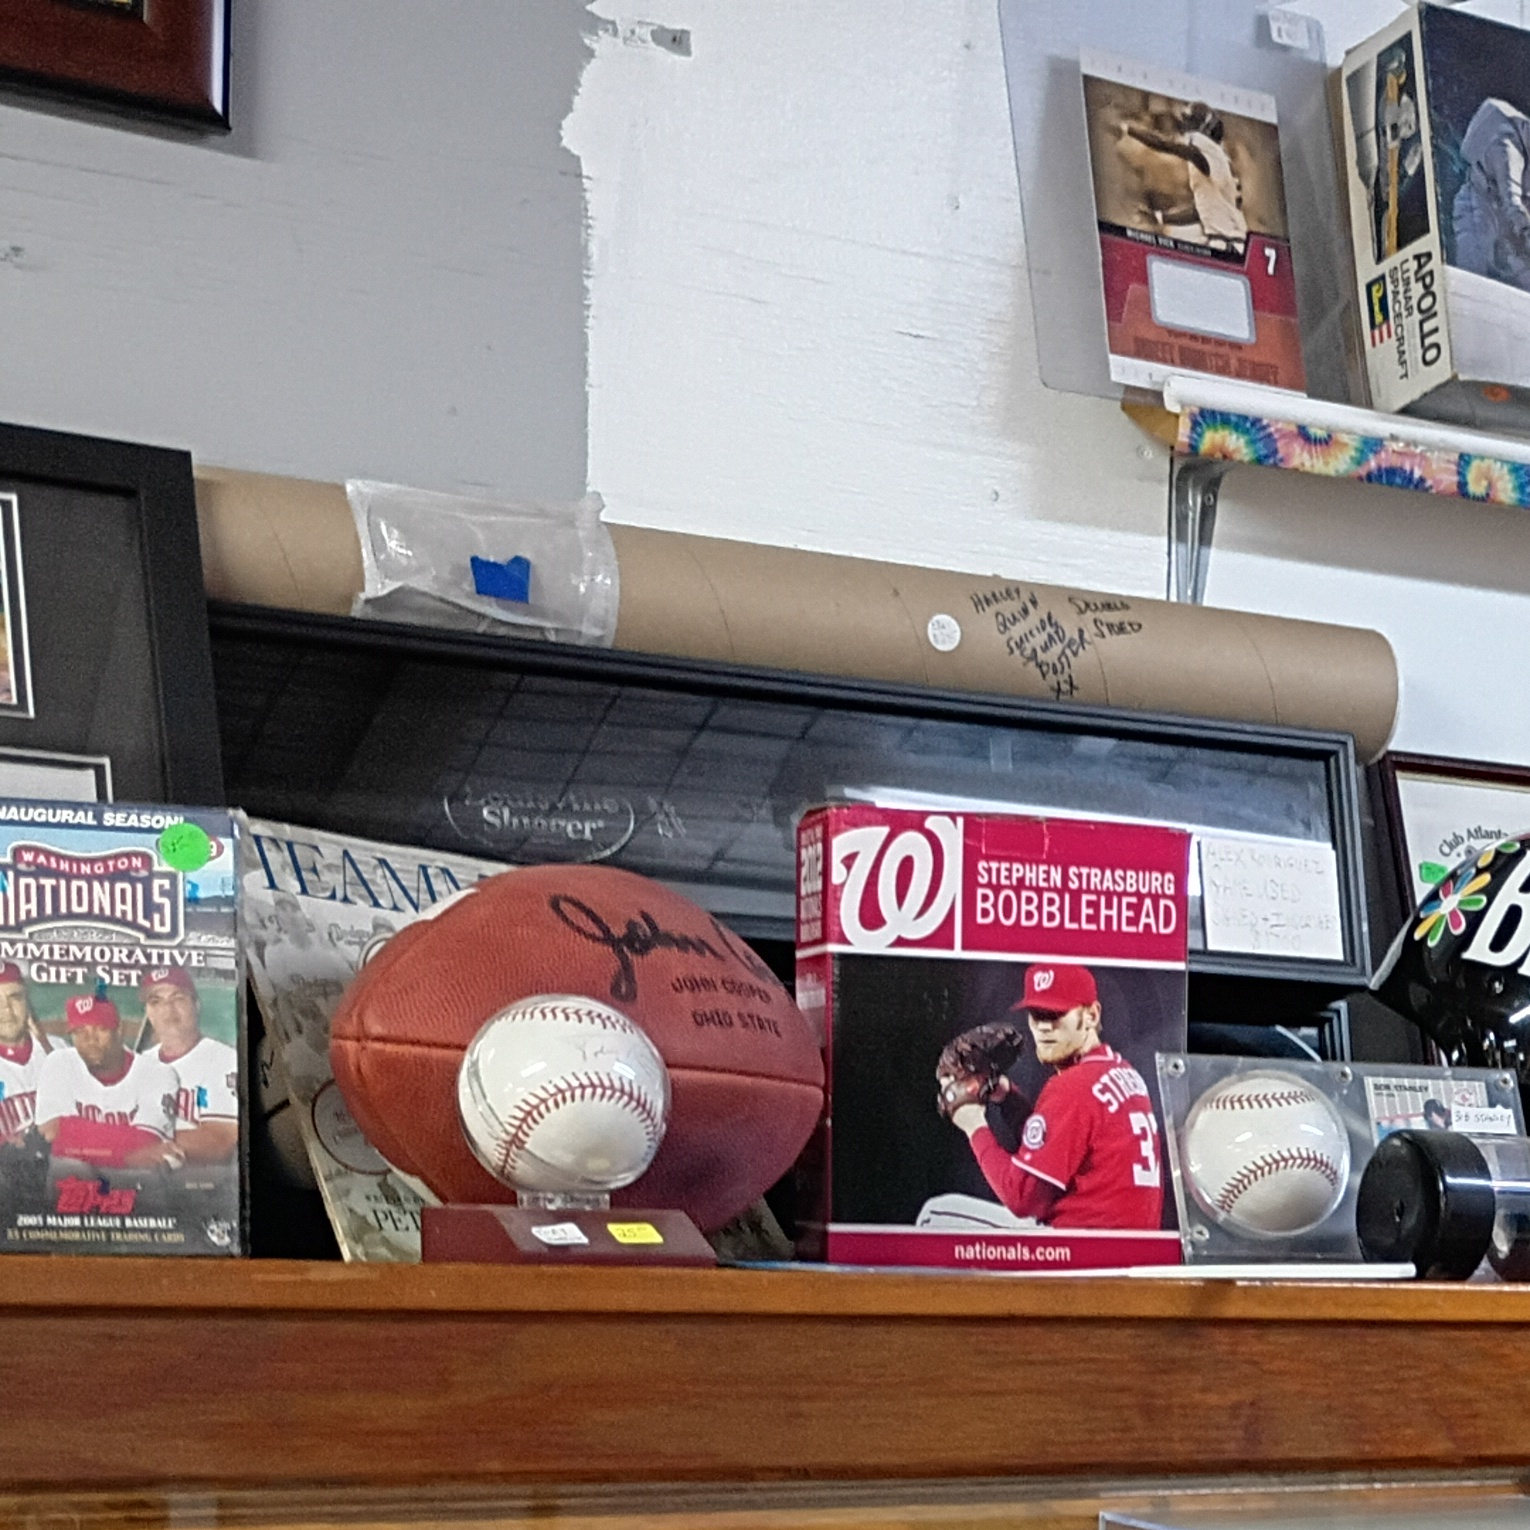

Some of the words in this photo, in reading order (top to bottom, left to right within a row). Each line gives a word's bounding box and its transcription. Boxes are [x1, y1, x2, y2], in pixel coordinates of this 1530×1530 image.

[1264, 246, 1277, 276] 7
[1400, 258, 1414, 319] LUNAR
[1389, 266, 1409, 380] SPACECRAFT
[1413, 251, 1441, 367] APOLLO
[1093, 618, 1142, 639] SIDED
[1040, 627, 1091, 680] POSTER
[1439, 832, 1465, 857] Club
[21, 851, 143, 876] WASHINGTON
[977, 860, 1062, 889] STEPHEN
[1067, 866, 1175, 896] STRASBURG
[0, 870, 171, 933] NATIONALS
[976, 888, 1178, 935] BOBBLEHEAD
[31, 963, 88, 984] GIFT
[96, 966, 142, 987] SET
[692, 1009, 734, 1029] OHIO
[737, 1012, 784, 1040] STATE
[954, 1241, 1071, 1262] nationals.com
